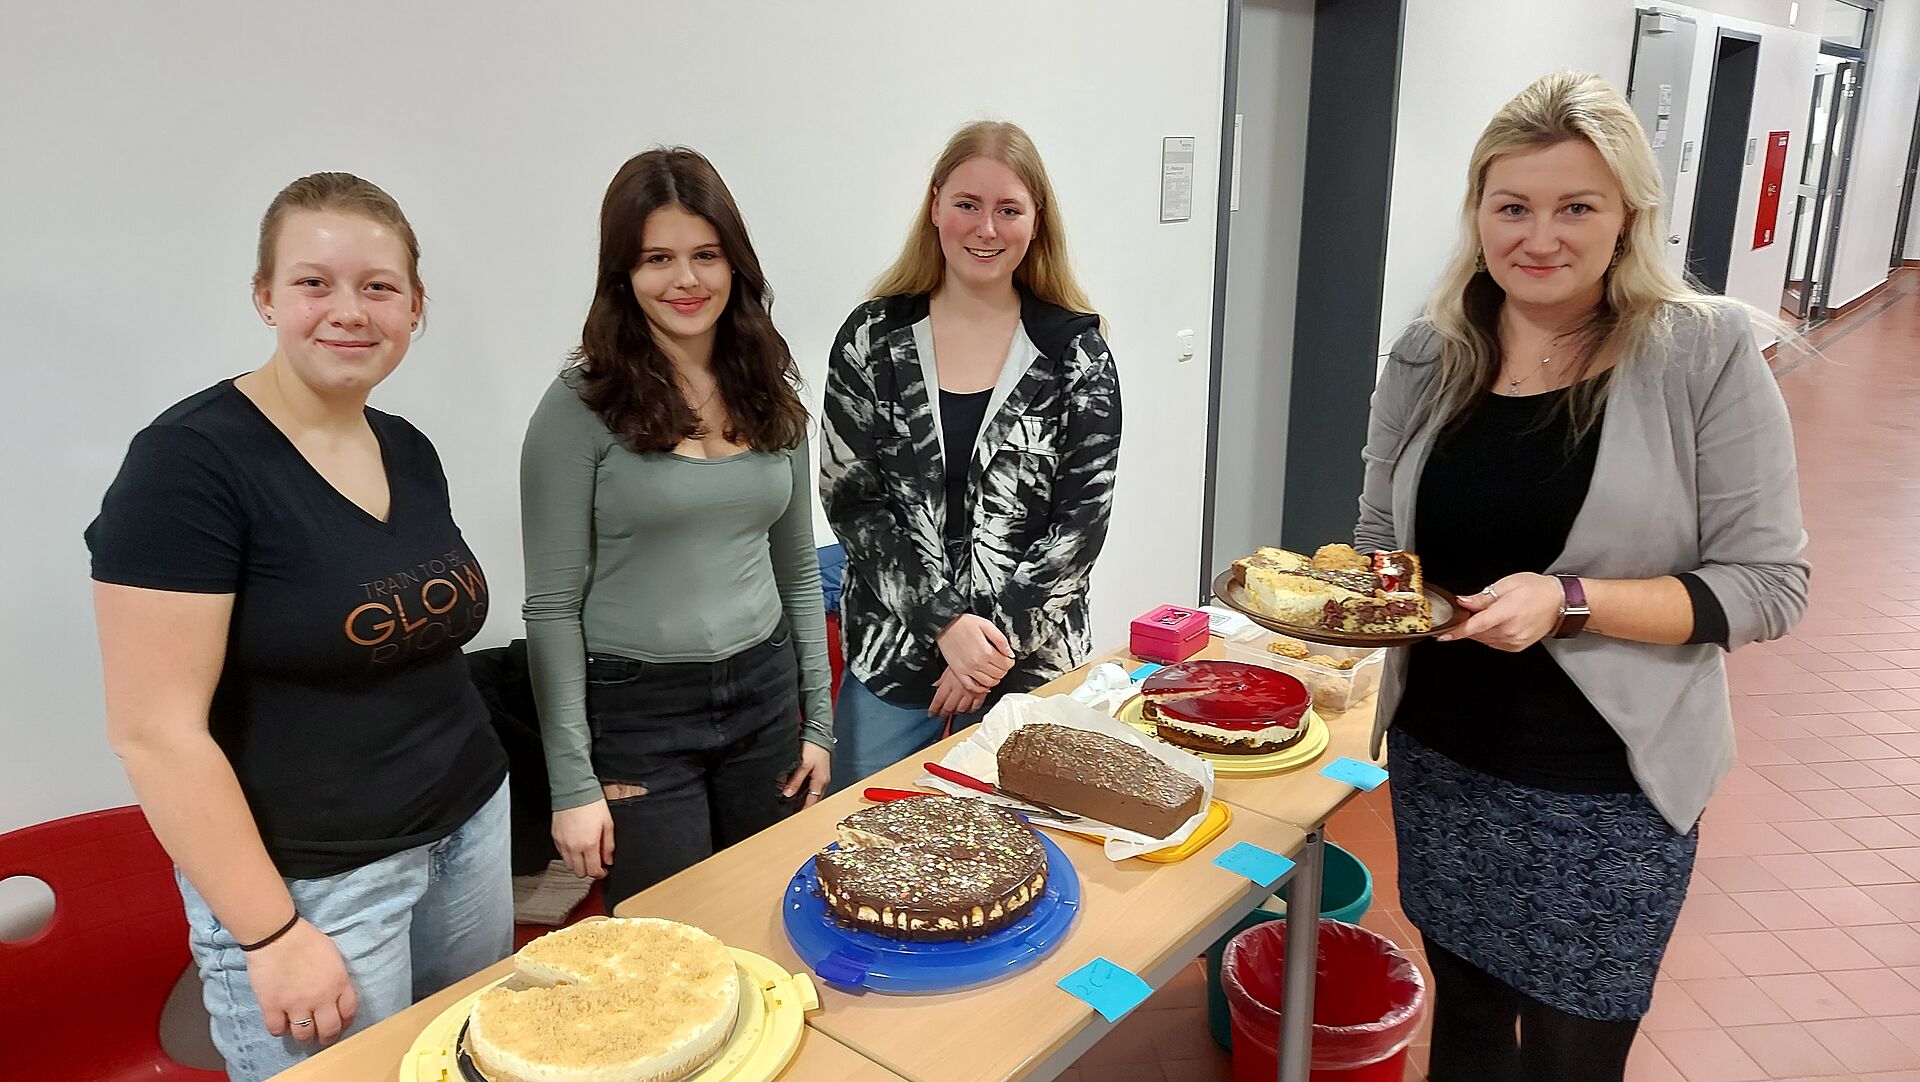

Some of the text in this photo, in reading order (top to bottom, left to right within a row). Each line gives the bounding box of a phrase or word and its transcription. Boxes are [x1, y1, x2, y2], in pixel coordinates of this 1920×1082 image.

[344, 560, 486, 646] GLOW
[359, 550, 464, 599] TRAIN TO BE
